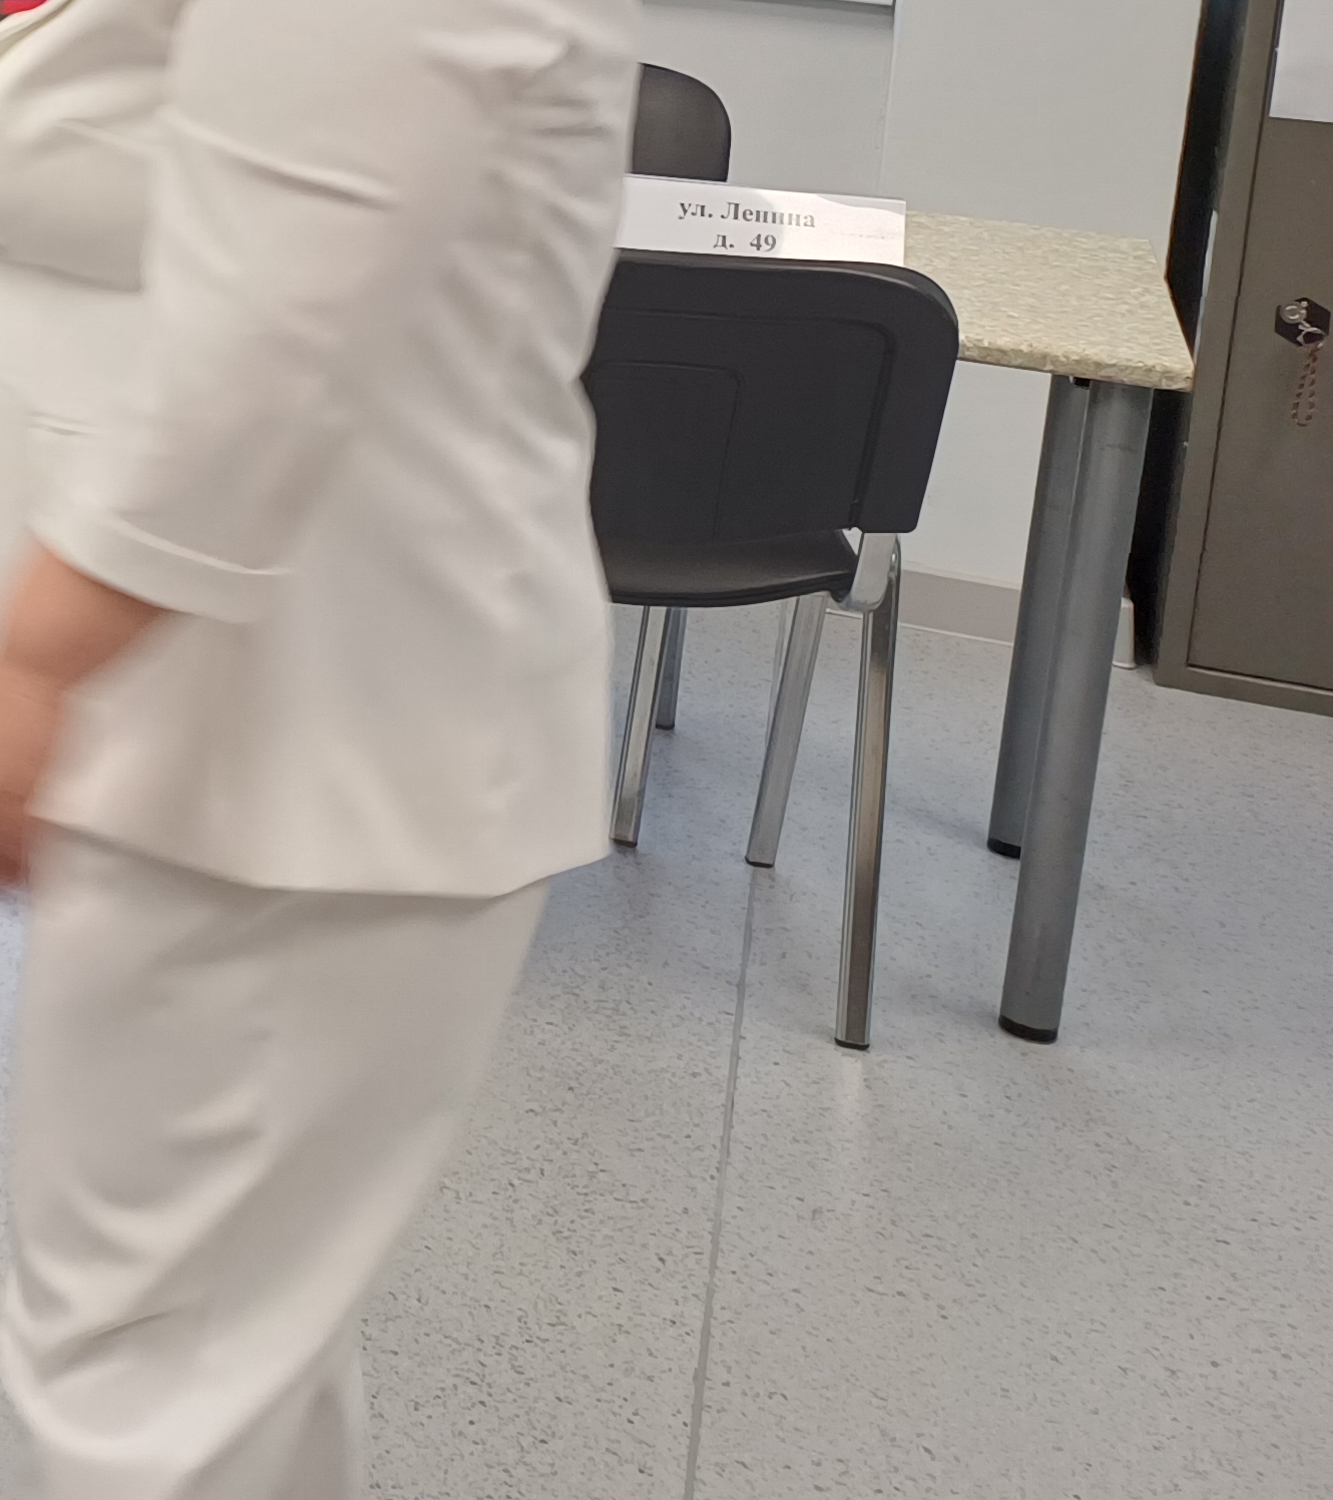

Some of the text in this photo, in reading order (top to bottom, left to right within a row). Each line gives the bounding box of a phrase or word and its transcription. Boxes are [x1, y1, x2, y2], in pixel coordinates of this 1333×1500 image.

[677, 201, 816, 229] ул. Ленина
[712, 233, 777, 252] д. 49
